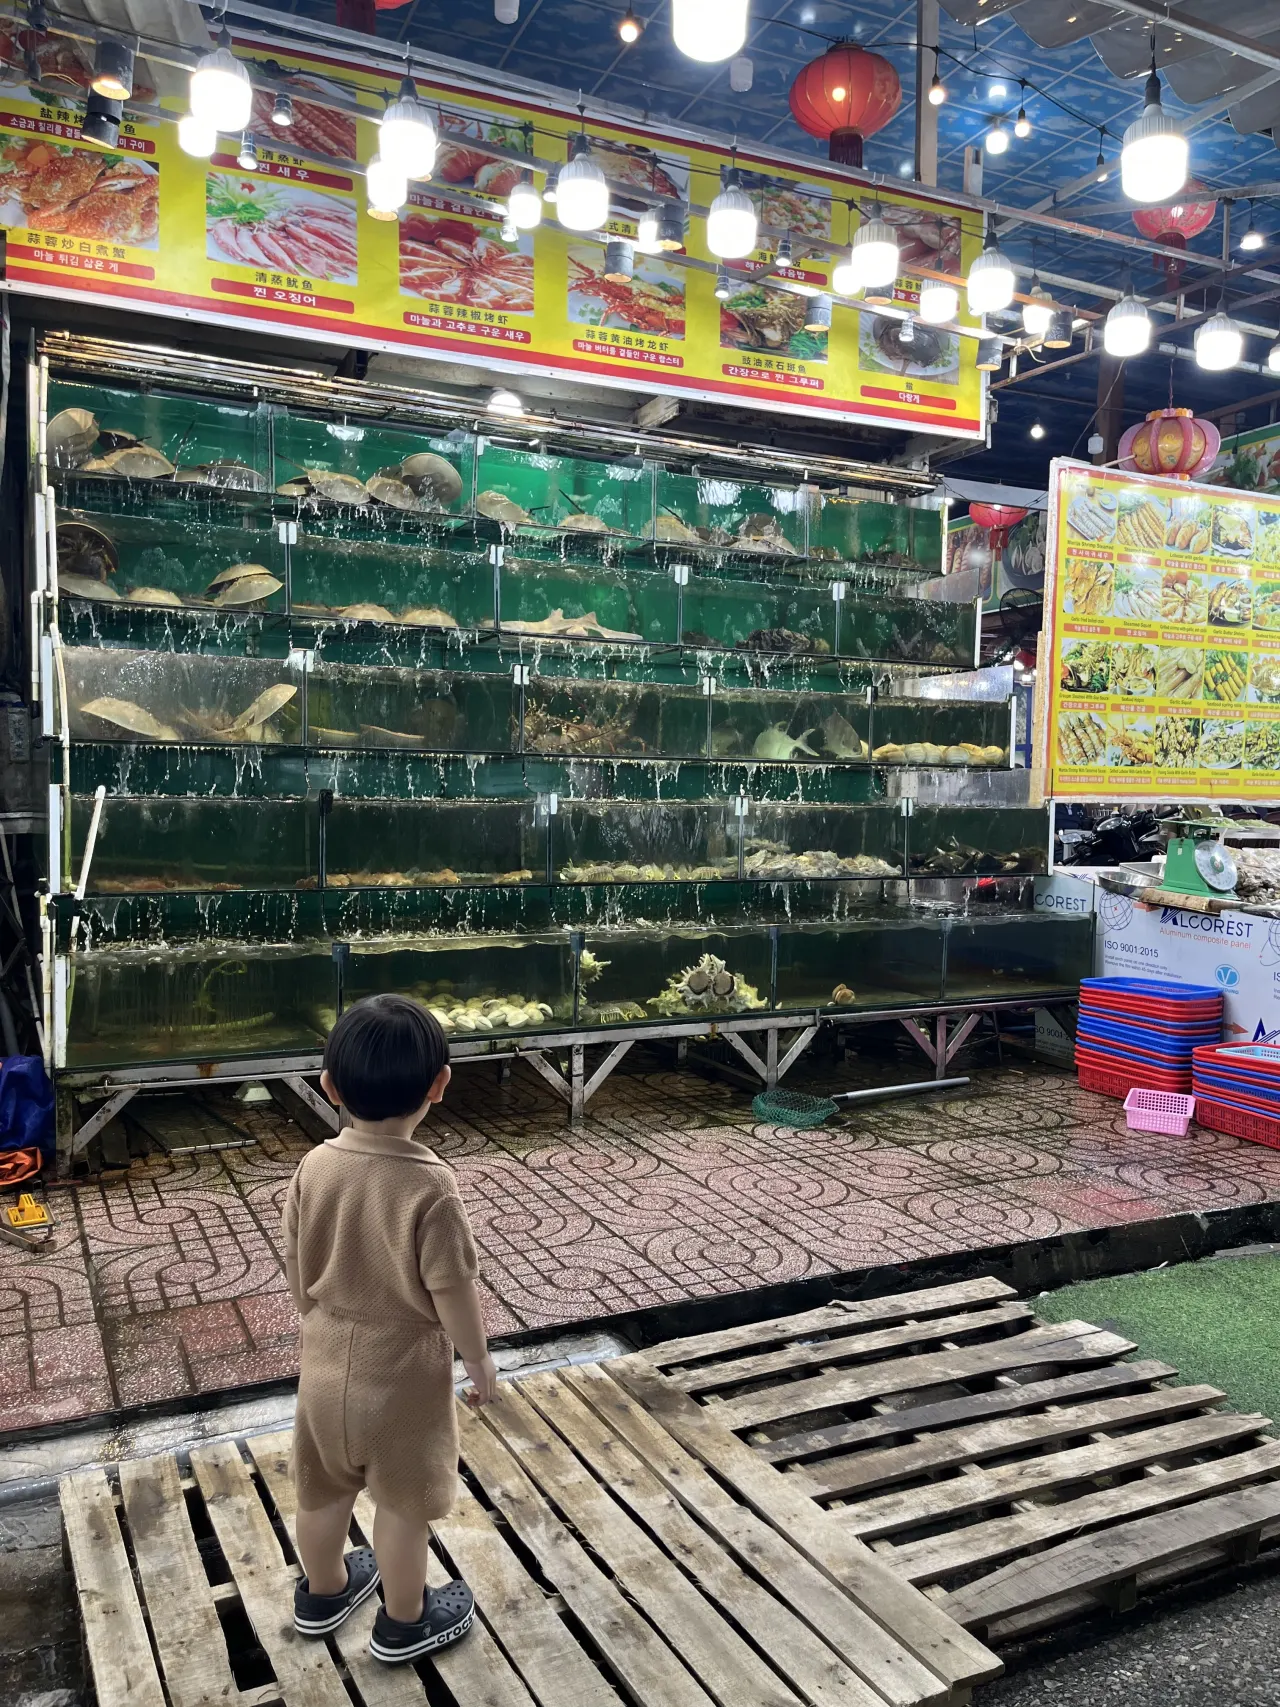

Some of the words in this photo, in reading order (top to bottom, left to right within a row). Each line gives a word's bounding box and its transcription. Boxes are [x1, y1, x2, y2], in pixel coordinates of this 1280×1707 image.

[10, 116, 36, 130] 소금과
[129, 138, 146, 151] 구이
[33, 249, 55, 263] 마늘
[58, 253, 80, 267] 튀김
[83, 258, 105, 271] 삶은
[108, 261, 120, 273] 게
[255, 270, 314, 292] 清蒸鱿鱼
[253, 286, 268, 299] 찐
[273, 290, 317, 307] 오징어
[428, 302, 509, 326] 蒜蓉辣椒烤虾
[409, 313, 443, 328] 마늘과
[445, 320, 477, 334] 고추로
[480, 325, 501, 338] 구운
[504, 330, 525, 342] 새우
[585, 328, 669, 352] 蒜蓉黄油烤龙虾
[577, 341, 593, 351] 마늘
[642, 353, 658, 363] 구운
[658, 355, 681, 367] 랍스터
[741, 354, 807, 375] 豉油蒸石斑鱼
[728, 365, 771, 381] 간장으로
[774, 372, 785, 383] 찐
[788, 376, 820, 390] 그루퍼
[1034, 893, 1087, 912] COREST
[1104, 940, 1119, 951] ISO
[1120, 943, 1159, 958] 9001:2015
[1159, 926, 1192, 940] Aluminum
[1193, 933, 1229, 946] composite
[1230, 939, 1252, 949] panel
[436, 1615, 473, 1645] crocs
